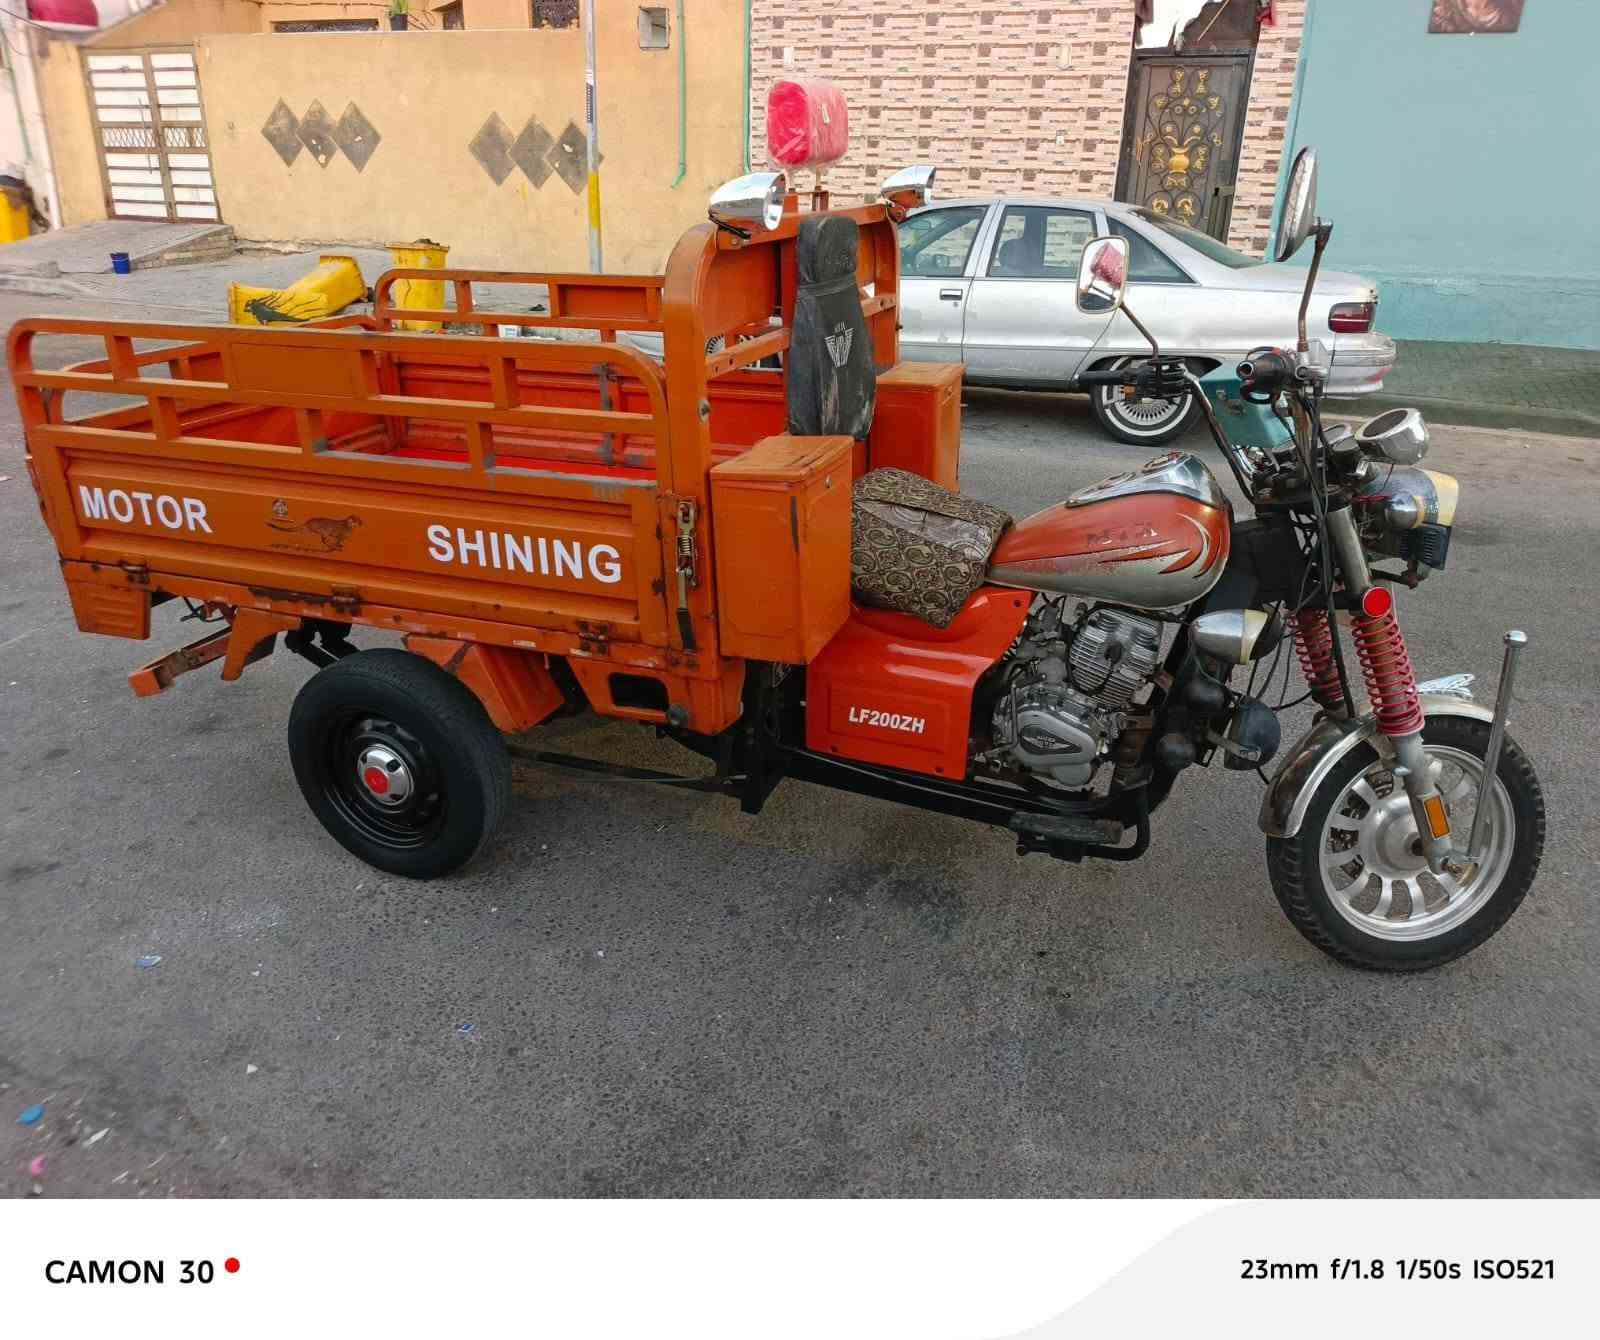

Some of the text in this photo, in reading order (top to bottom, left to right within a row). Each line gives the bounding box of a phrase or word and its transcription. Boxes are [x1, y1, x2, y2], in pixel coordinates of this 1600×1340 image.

[79, 485, 622, 585] MOTOR SHINING
[848, 706, 926, 734] LF200ZH
